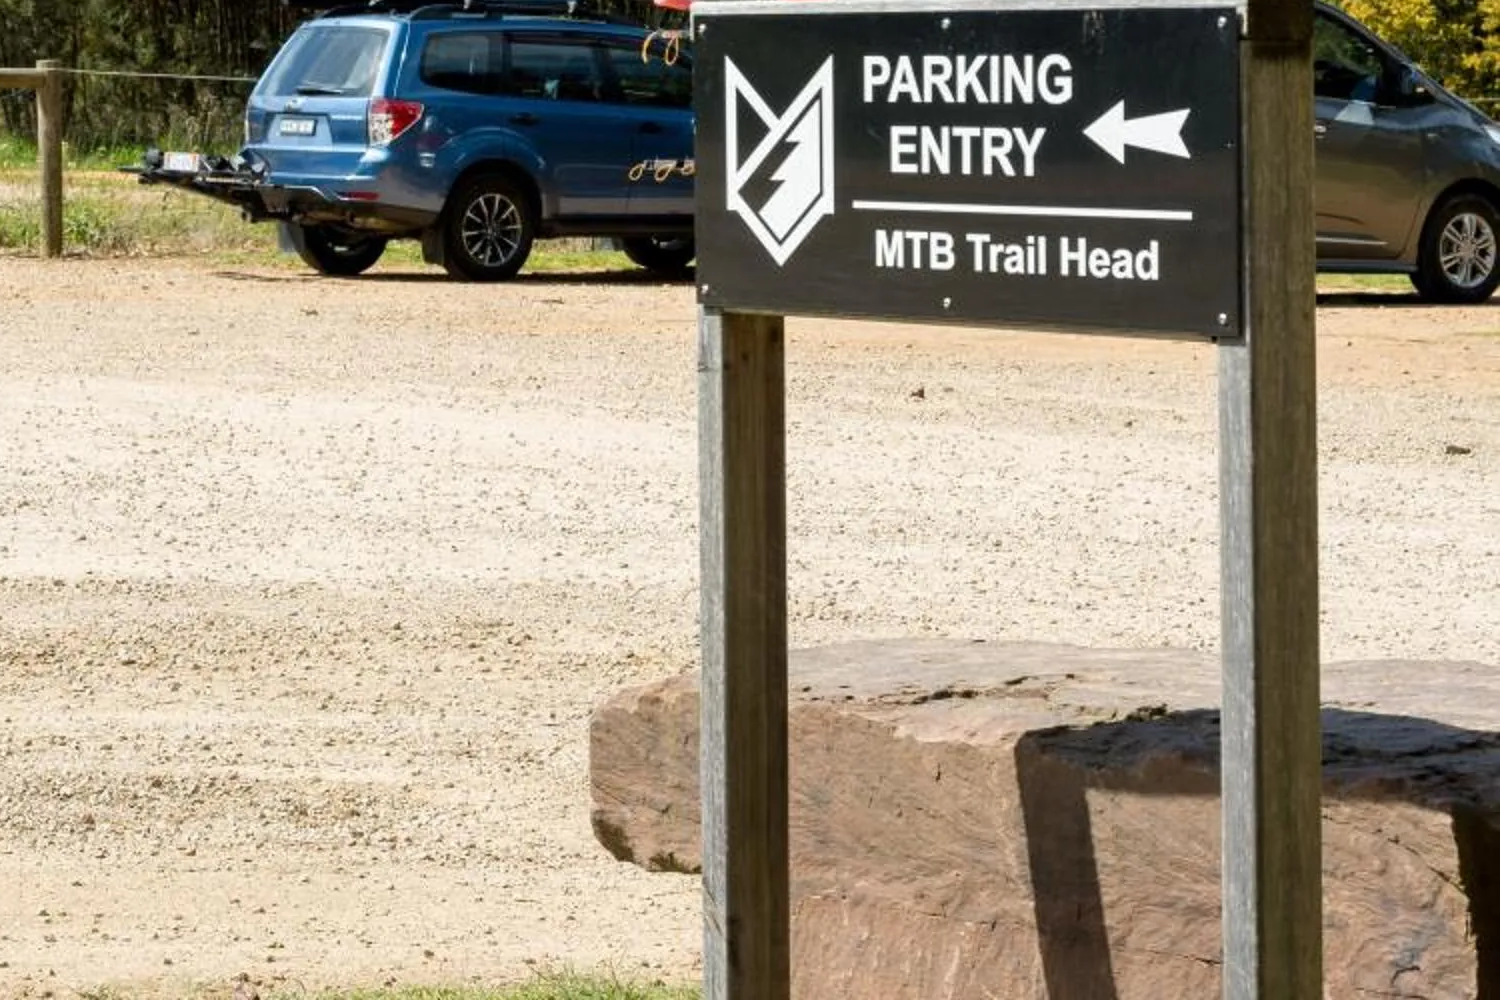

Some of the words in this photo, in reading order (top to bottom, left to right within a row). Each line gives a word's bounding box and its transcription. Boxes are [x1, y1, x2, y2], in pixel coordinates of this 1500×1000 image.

[863, 53, 1074, 105] PARKING
[890, 125, 1047, 177] ENTRY
[875, 229, 956, 271] MTB
[965, 233, 1047, 275] Trail
[1059, 236, 1160, 281] Head
